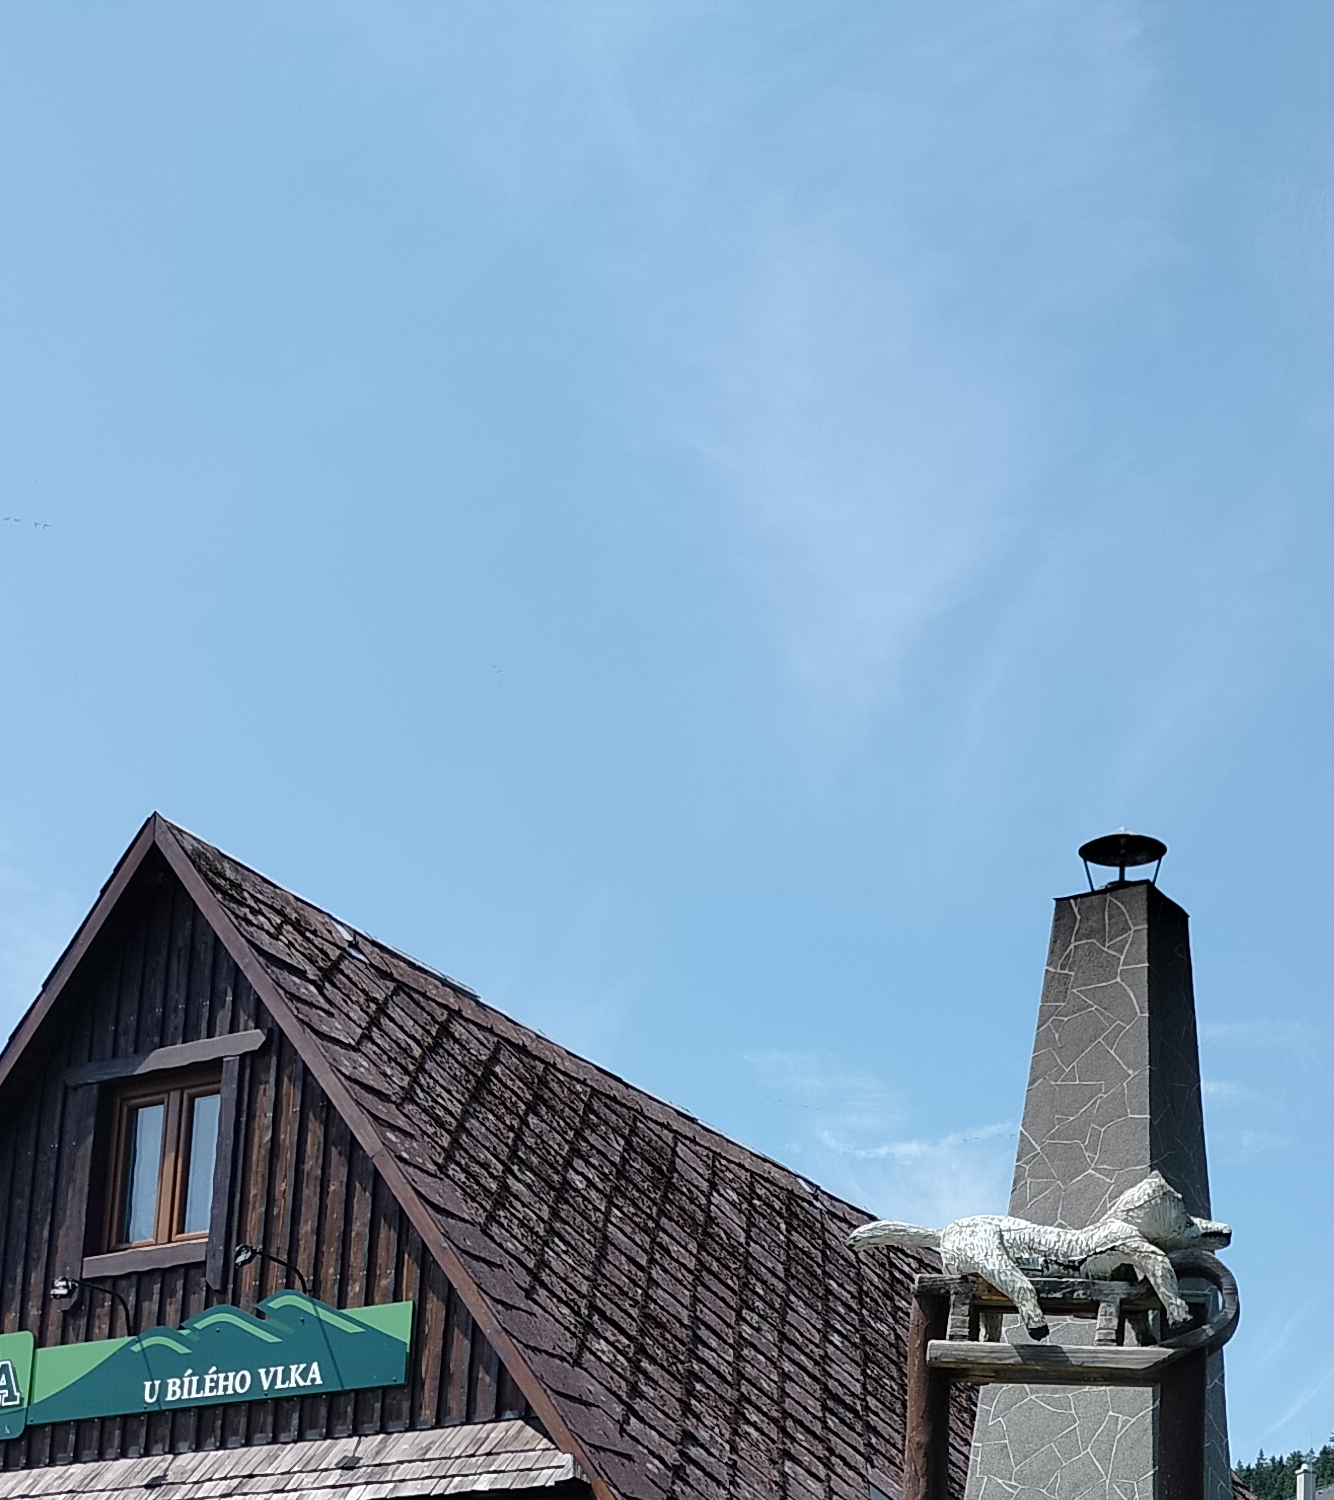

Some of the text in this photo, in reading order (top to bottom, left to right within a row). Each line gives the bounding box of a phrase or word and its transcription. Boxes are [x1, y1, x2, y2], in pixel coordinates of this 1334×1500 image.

[143, 1361, 323, 1403] U BÍLÉHO VLKA
